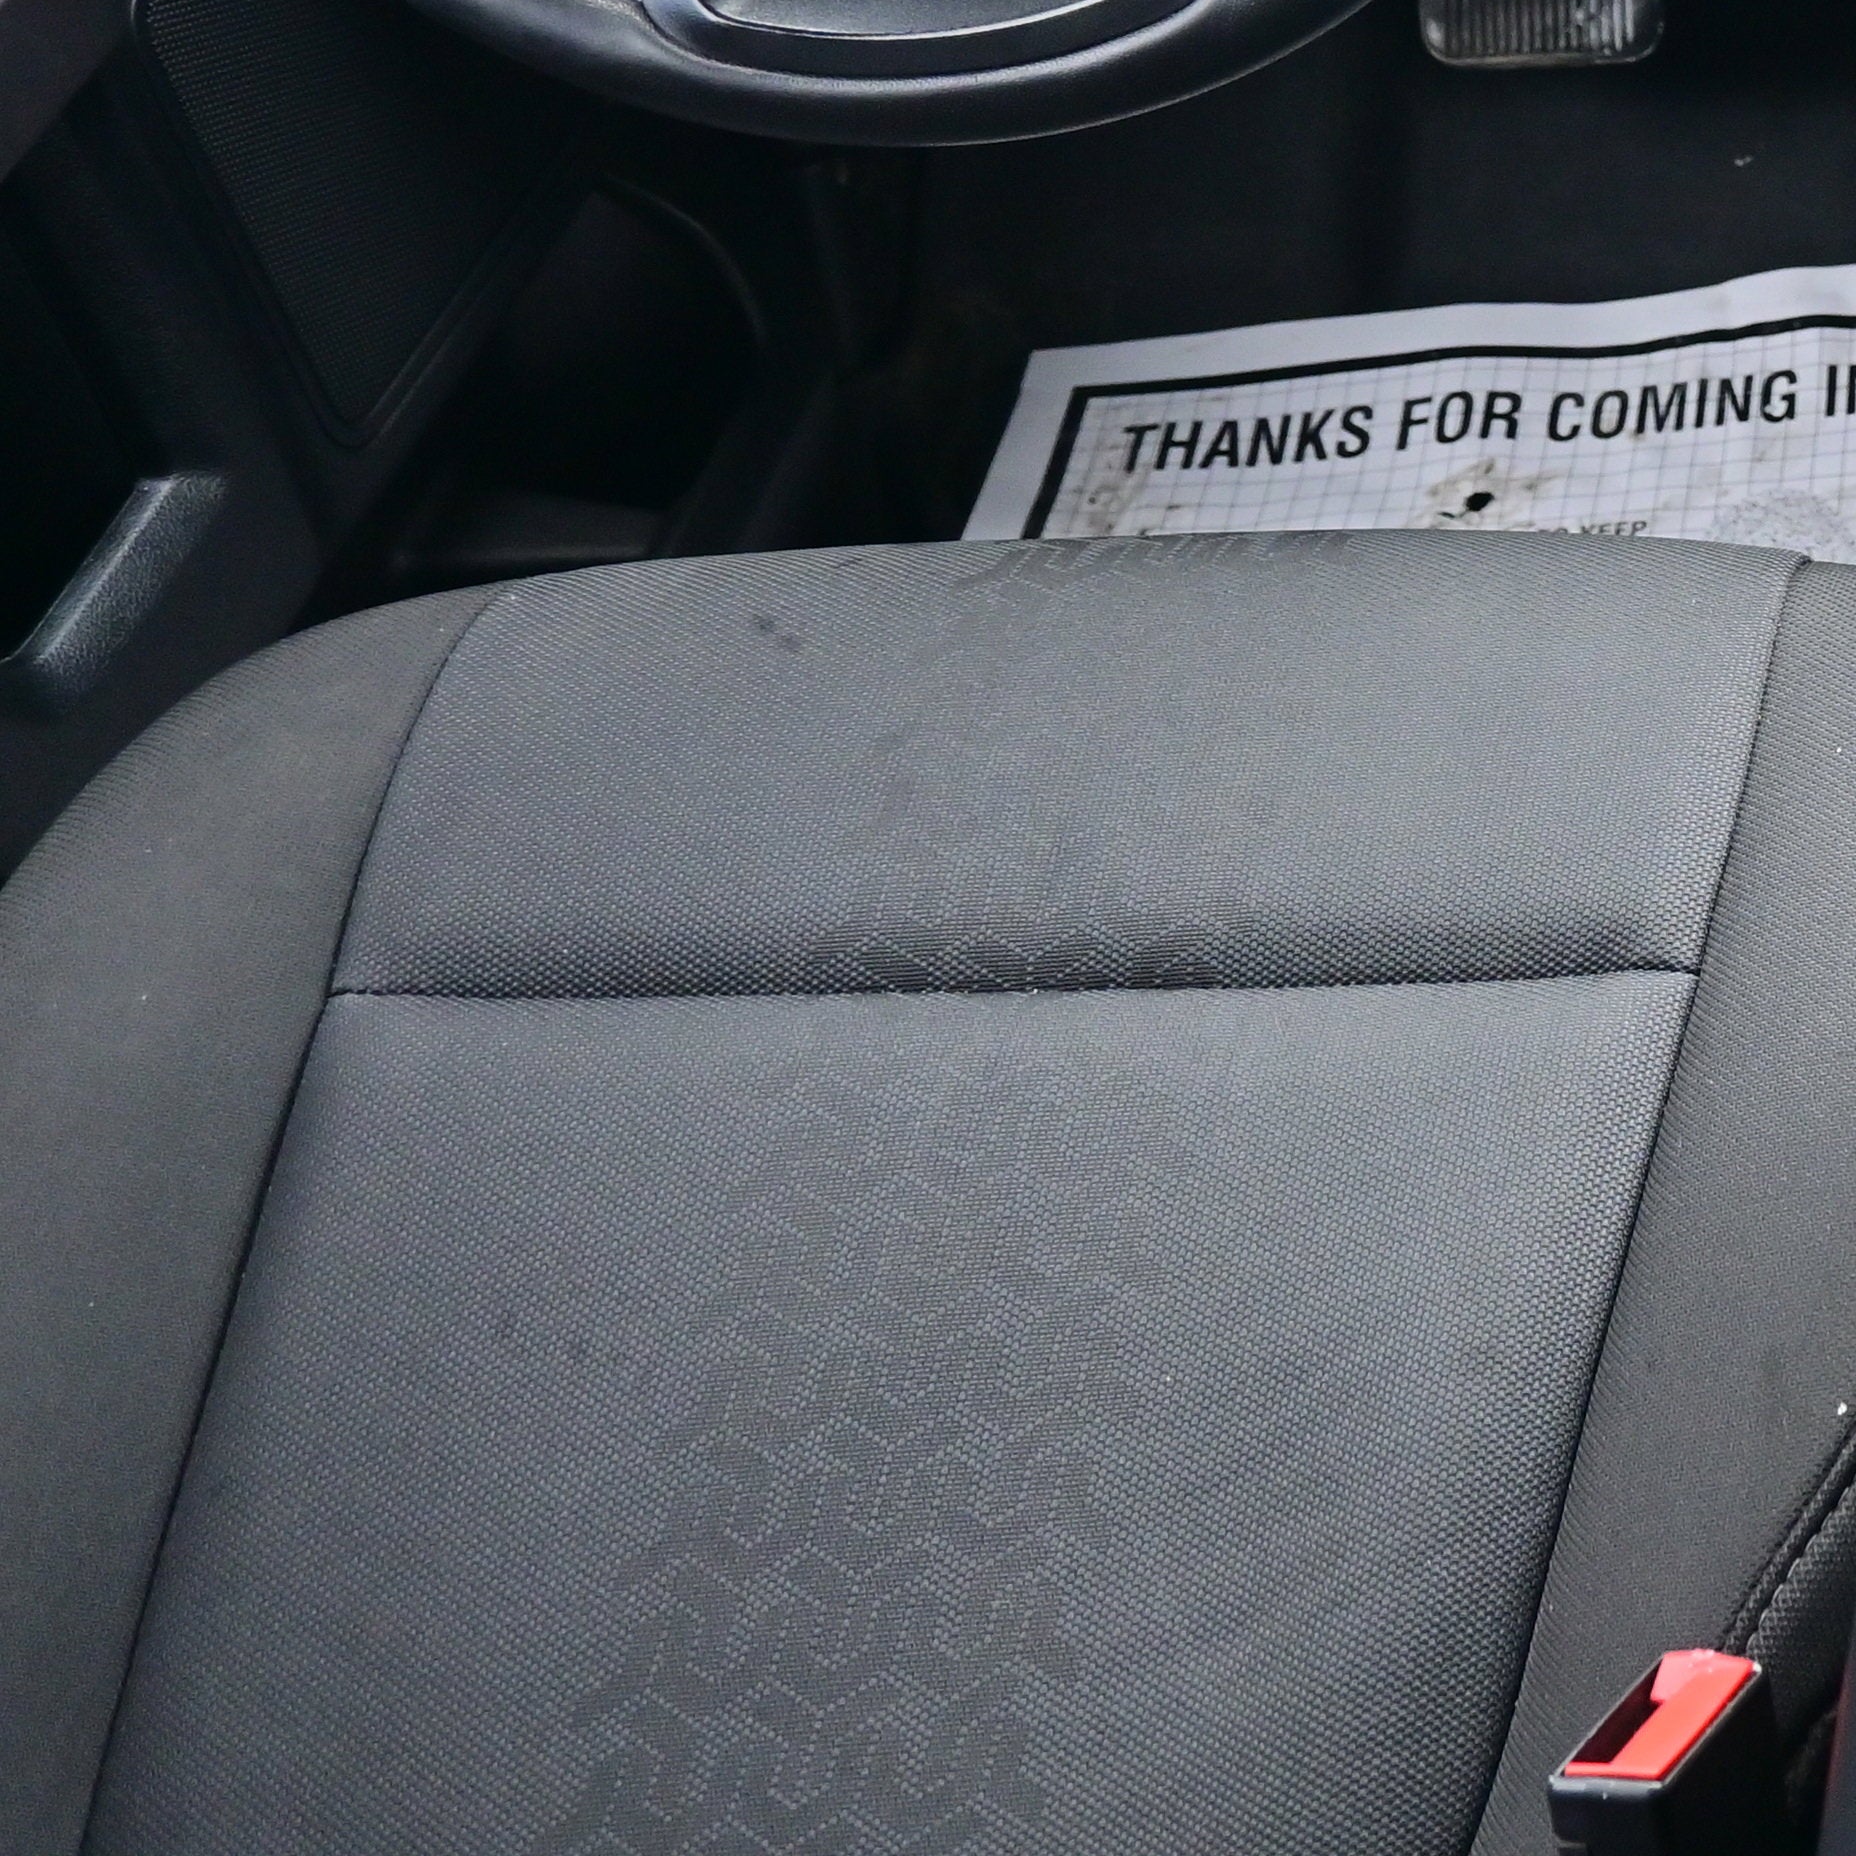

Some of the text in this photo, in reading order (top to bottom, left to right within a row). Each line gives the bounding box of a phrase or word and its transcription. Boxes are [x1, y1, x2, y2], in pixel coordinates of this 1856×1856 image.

[1120, 405, 1373, 476] THANKS
[1396, 390, 1523, 452] FOR
[1548, 370, 1800, 444] COMING
